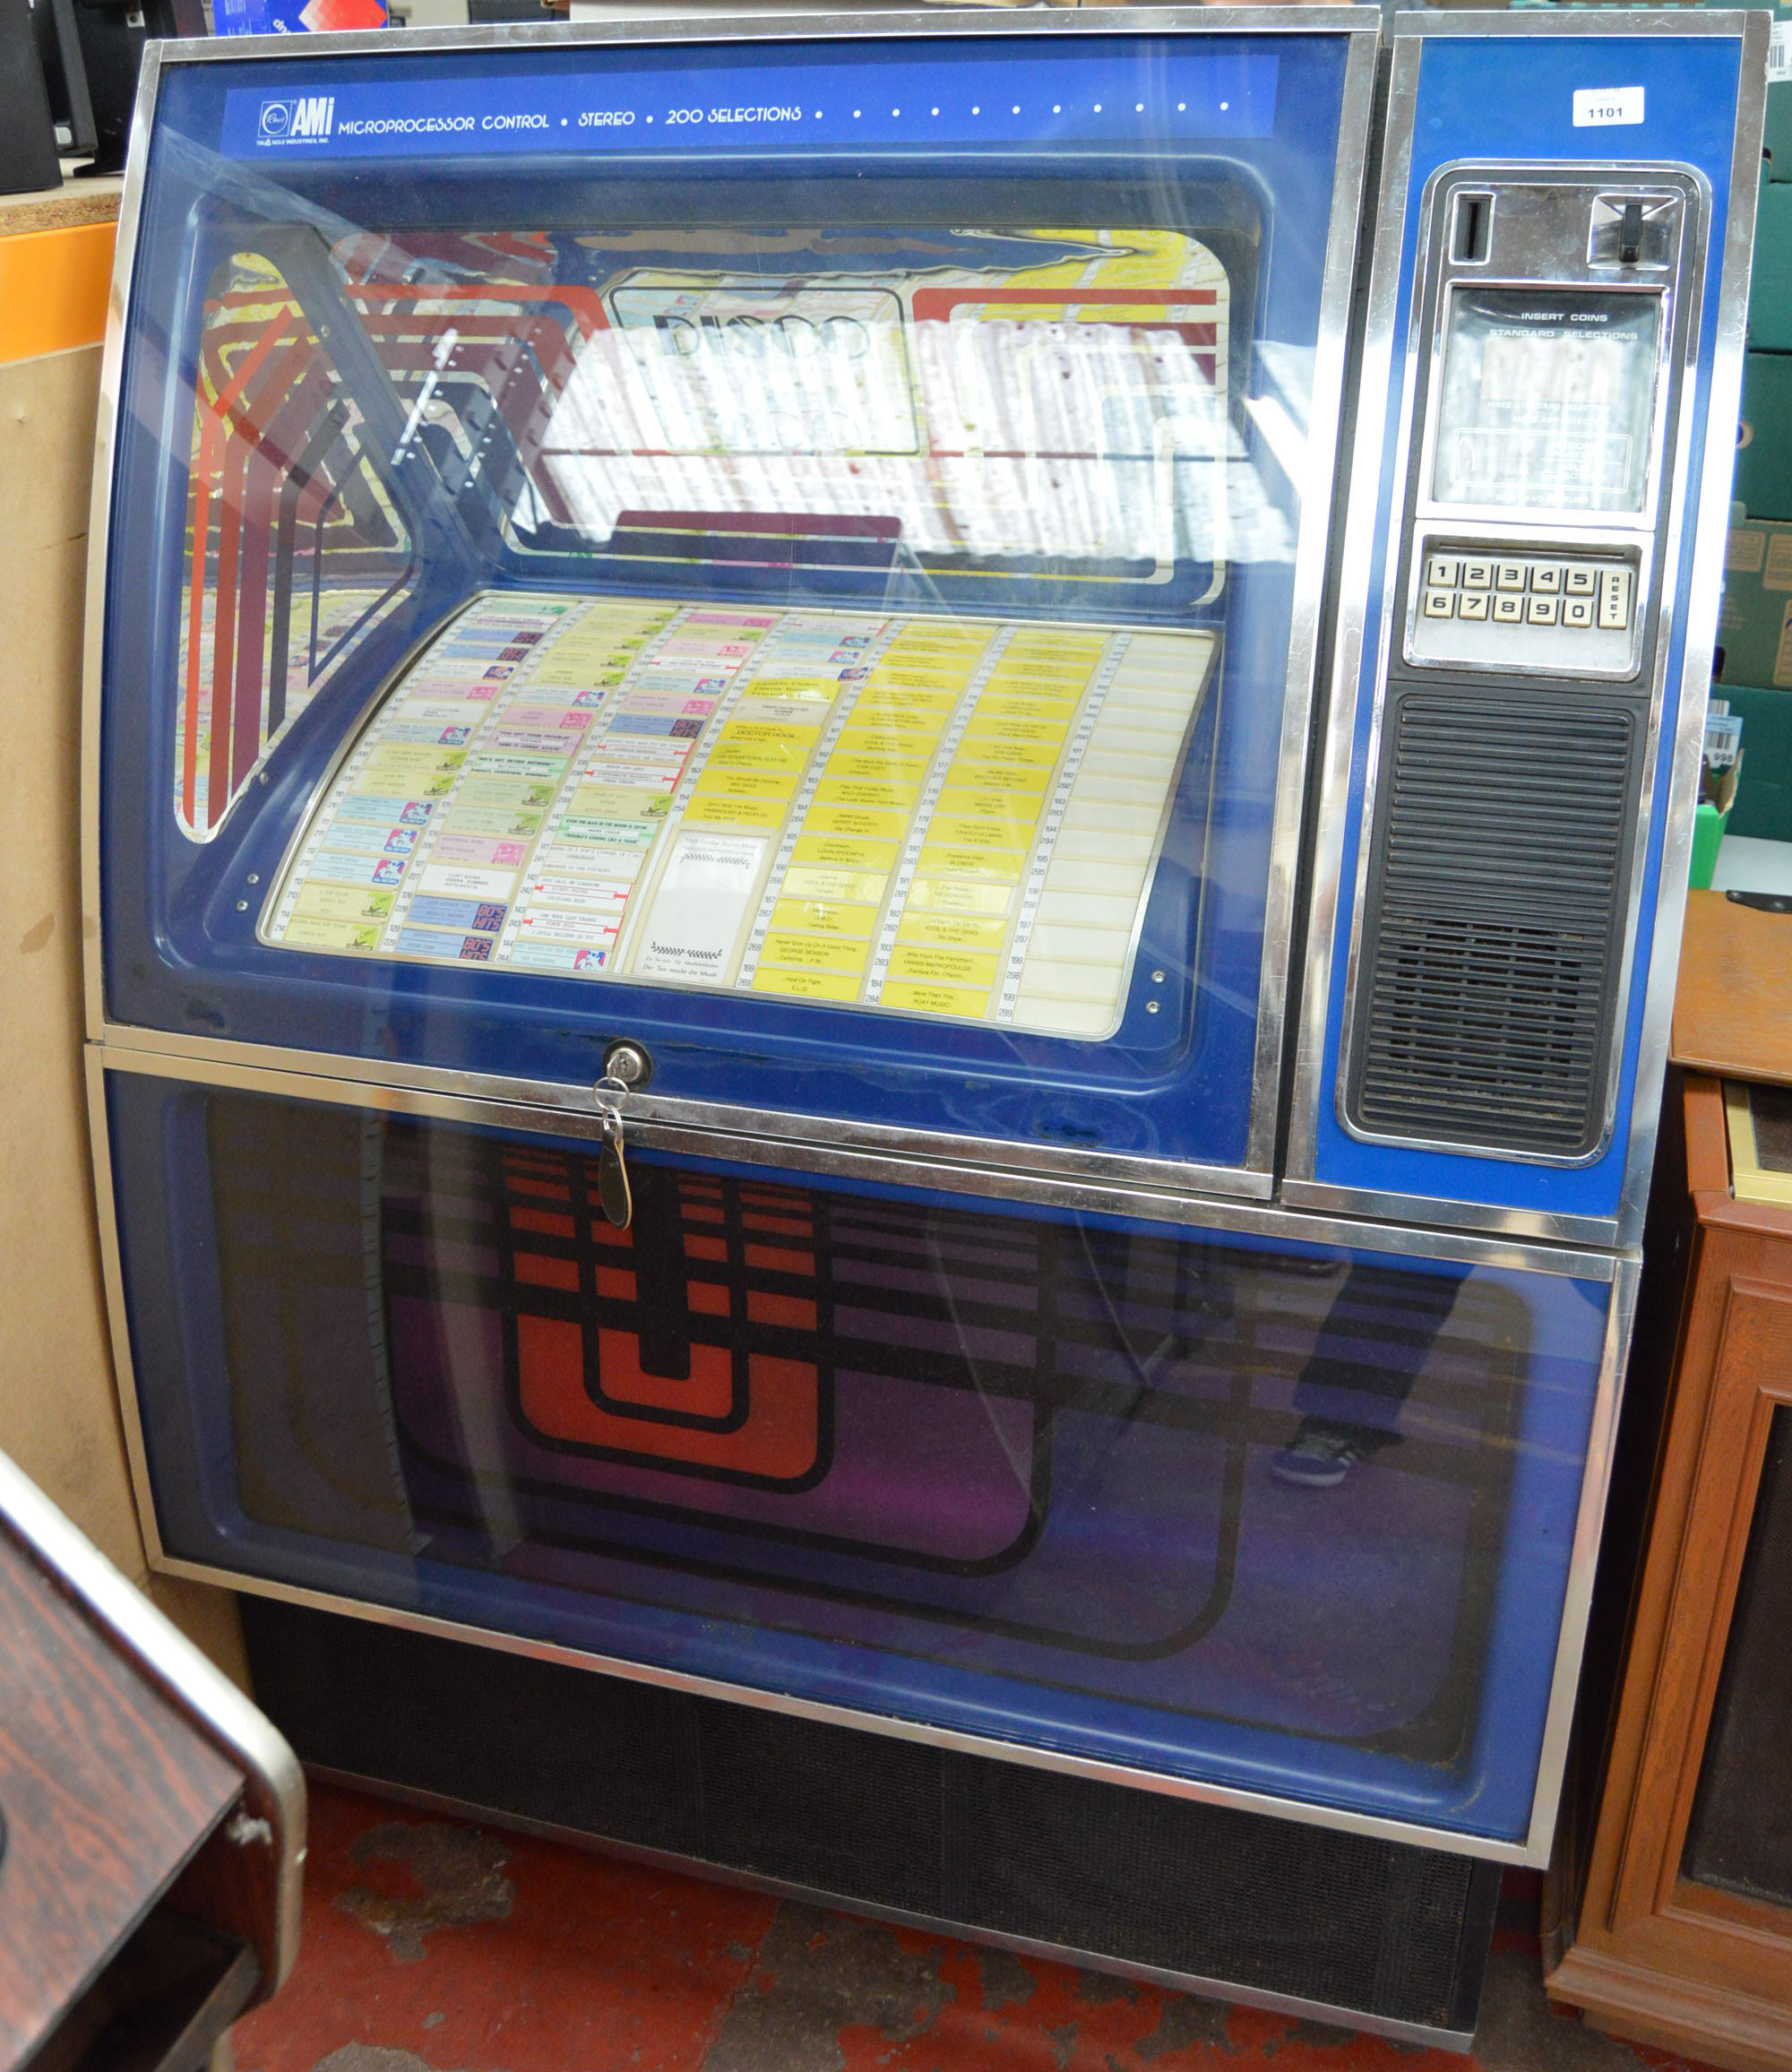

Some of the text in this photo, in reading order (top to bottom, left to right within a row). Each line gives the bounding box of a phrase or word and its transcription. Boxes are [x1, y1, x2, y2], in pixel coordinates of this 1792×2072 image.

[1588, 107, 1623, 118] 1101
[338, 106, 802, 135] MICROPROCESSOR CONTROL STEREO 200 SELECTIONS
[1521, 312, 1608, 323] INSERT COINS
[1489, 329, 1638, 341] STANDARD SELECTIONS
[1438, 565, 1588, 585] 1 2 3 4 5
[1609, 576, 1620, 620] RESET
[1432, 597, 1585, 618] 6 7 8 9 0
[473, 918, 502, 931] HITS
[874, 958, 889, 966] 283
[865, 995, 879, 1003] 284
[1003, 993, 1015, 1001] 199
[998, 1008, 1012, 1017] 299
